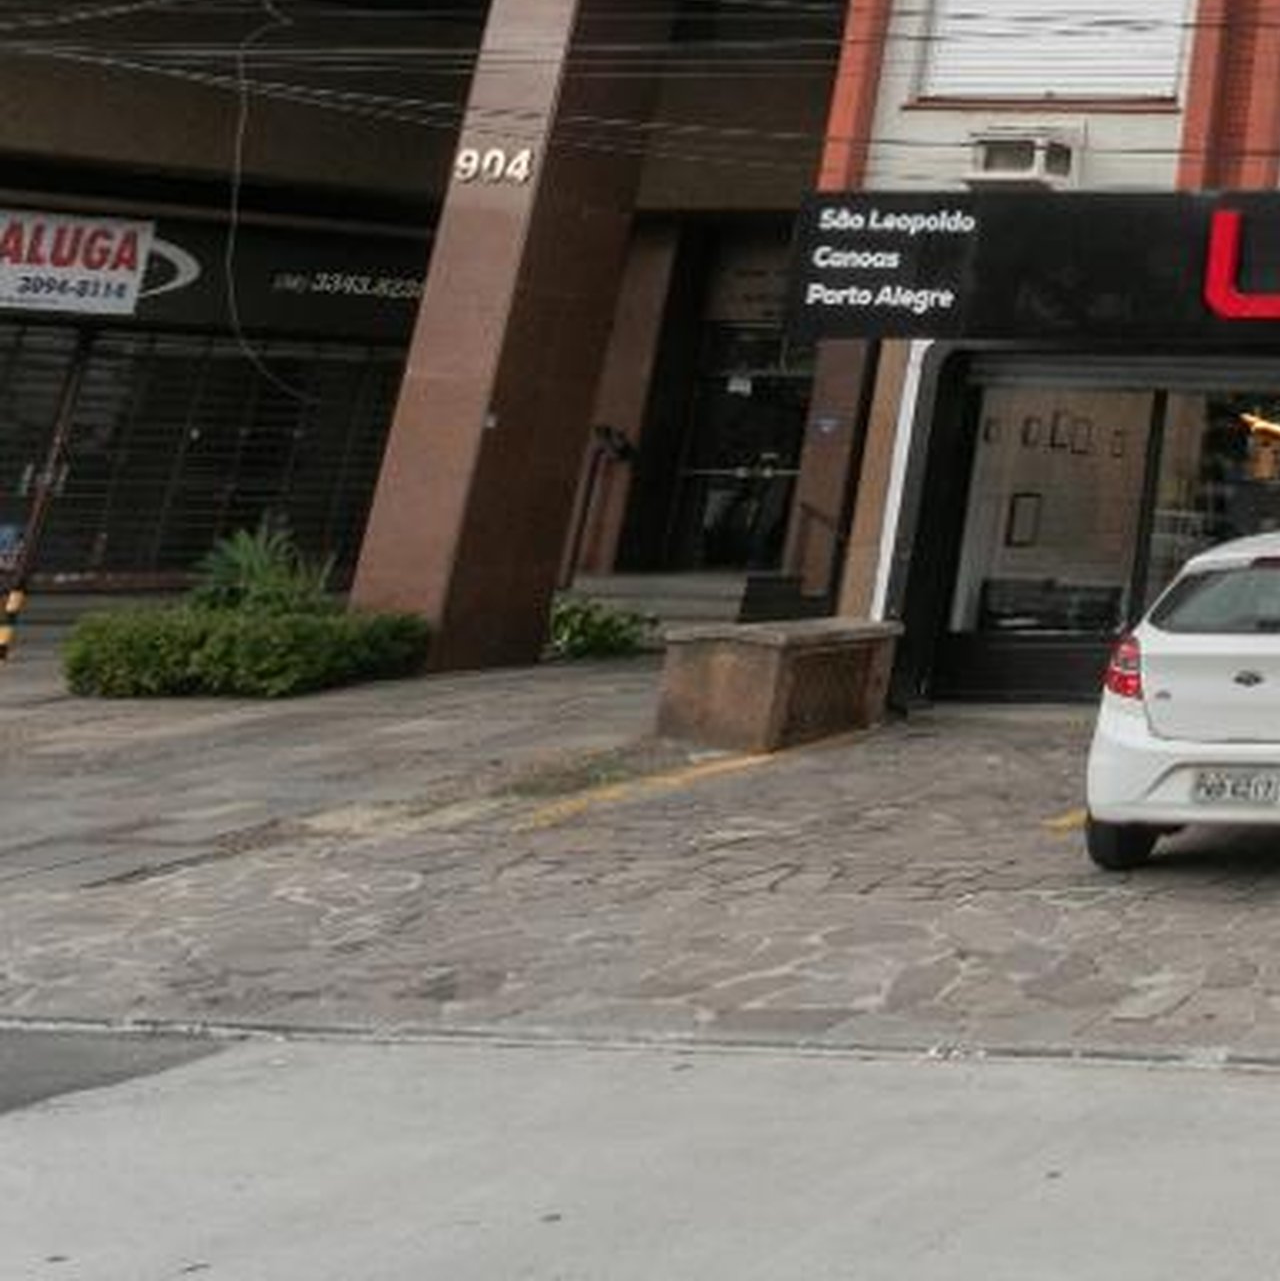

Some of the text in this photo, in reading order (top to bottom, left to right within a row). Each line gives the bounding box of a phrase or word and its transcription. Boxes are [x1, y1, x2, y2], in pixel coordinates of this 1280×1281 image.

[454, 148, 531, 181] 904
[819, 208, 976, 235] São Leopoldo
[0, 220, 138, 270] ALUGA
[812, 246, 900, 268] Canoas
[805, 282, 955, 314] Porto Alegre
